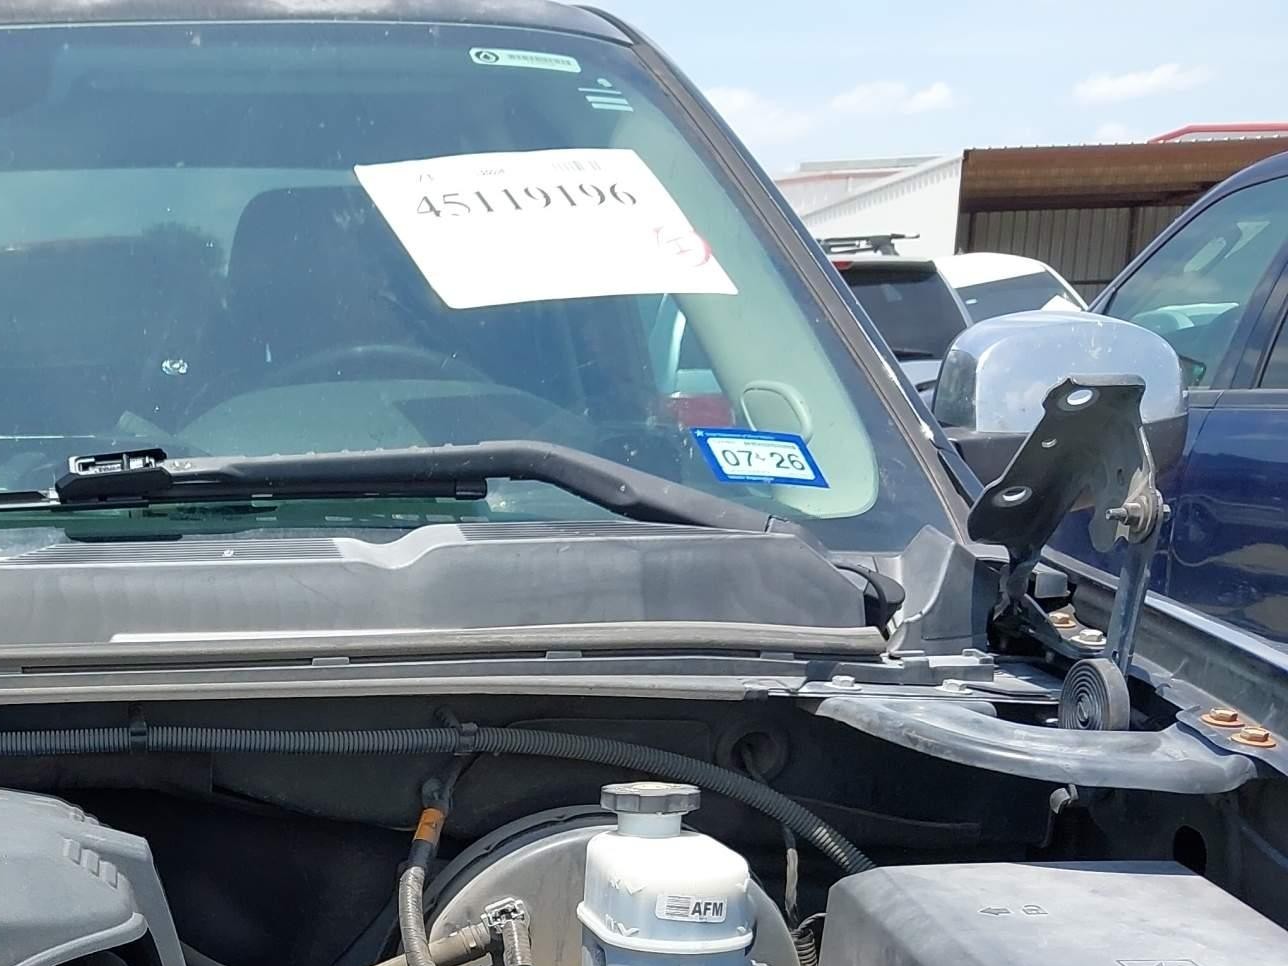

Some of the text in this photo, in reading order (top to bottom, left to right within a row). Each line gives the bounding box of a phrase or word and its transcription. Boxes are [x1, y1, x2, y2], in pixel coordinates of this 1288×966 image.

[416, 183, 638, 217] 45119196
[722, 449, 806, 471] 07 26
[691, 901, 724, 917] AFM
